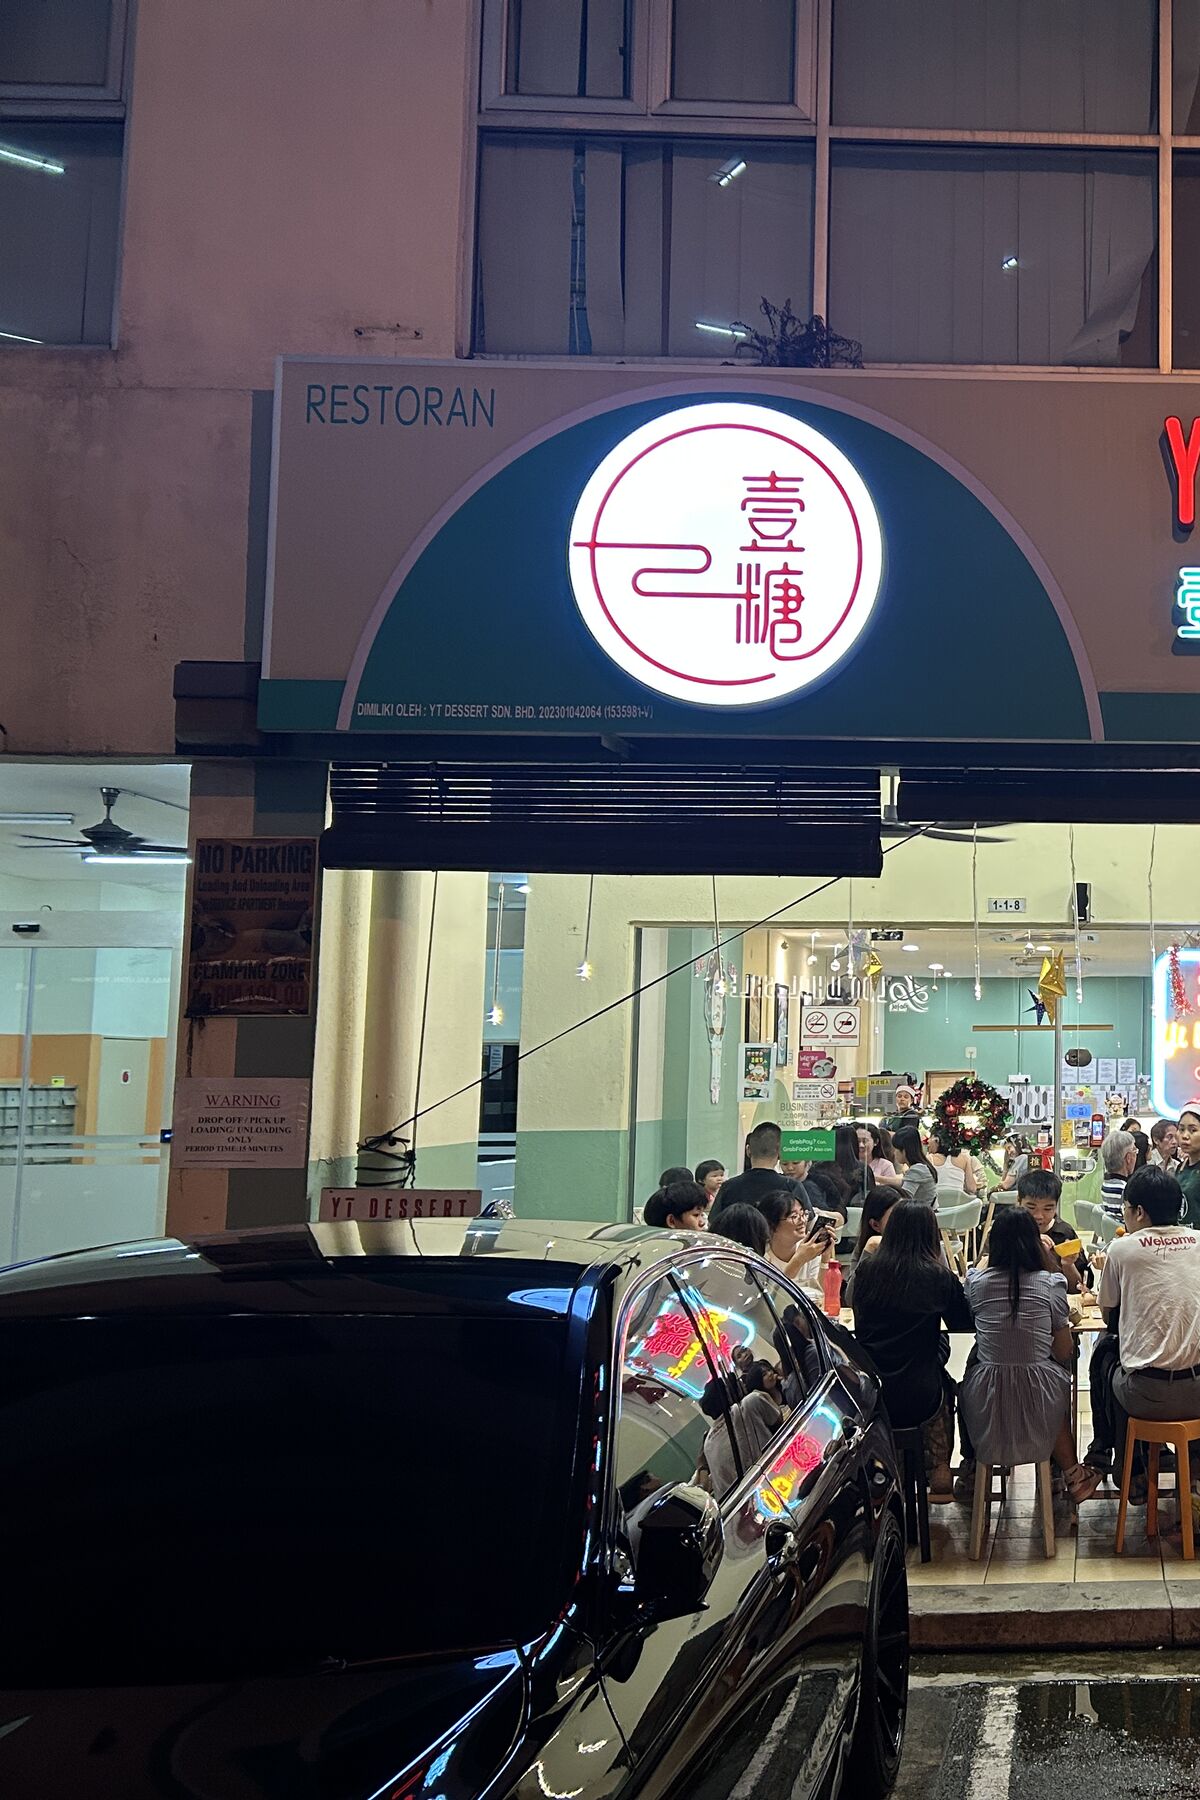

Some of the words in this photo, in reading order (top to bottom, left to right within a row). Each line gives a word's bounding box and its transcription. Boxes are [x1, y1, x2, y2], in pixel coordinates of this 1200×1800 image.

[306, 384, 496, 428] RESTORAN
[357, 703, 394, 716] DIMILIKI
[429, 704, 442, 717] YT
[445, 704, 489, 718] DESSERT
[491, 705, 512, 718] SDN.
[515, 705, 536, 718] BHD.
[539, 705, 601, 718] 202301042064
[199, 845, 225, 873] NO
[231, 845, 313, 874] PARKING
[993, 900, 1020, 911] 1-1-8
[193, 961, 266, 980] CLAMPING
[271, 962, 305, 980] ZONE
[206, 1094, 281, 1107] WARNING
[198, 1116, 224, 1125] DROP
[225, 1116, 242, 1124] OFF
[250, 1116, 272, 1124] PICK
[273, 1116, 286, 1124] UP
[237, 1126, 292, 1134] UNLOADING
[227, 1136, 254, 1144] ONLY
[249, 1145, 284, 1153] MINUTES
[331, 1196, 355, 1218] YT
[369, 1197, 468, 1218] DESSERT
[1139, 1236, 1197, 1248] Welcome
